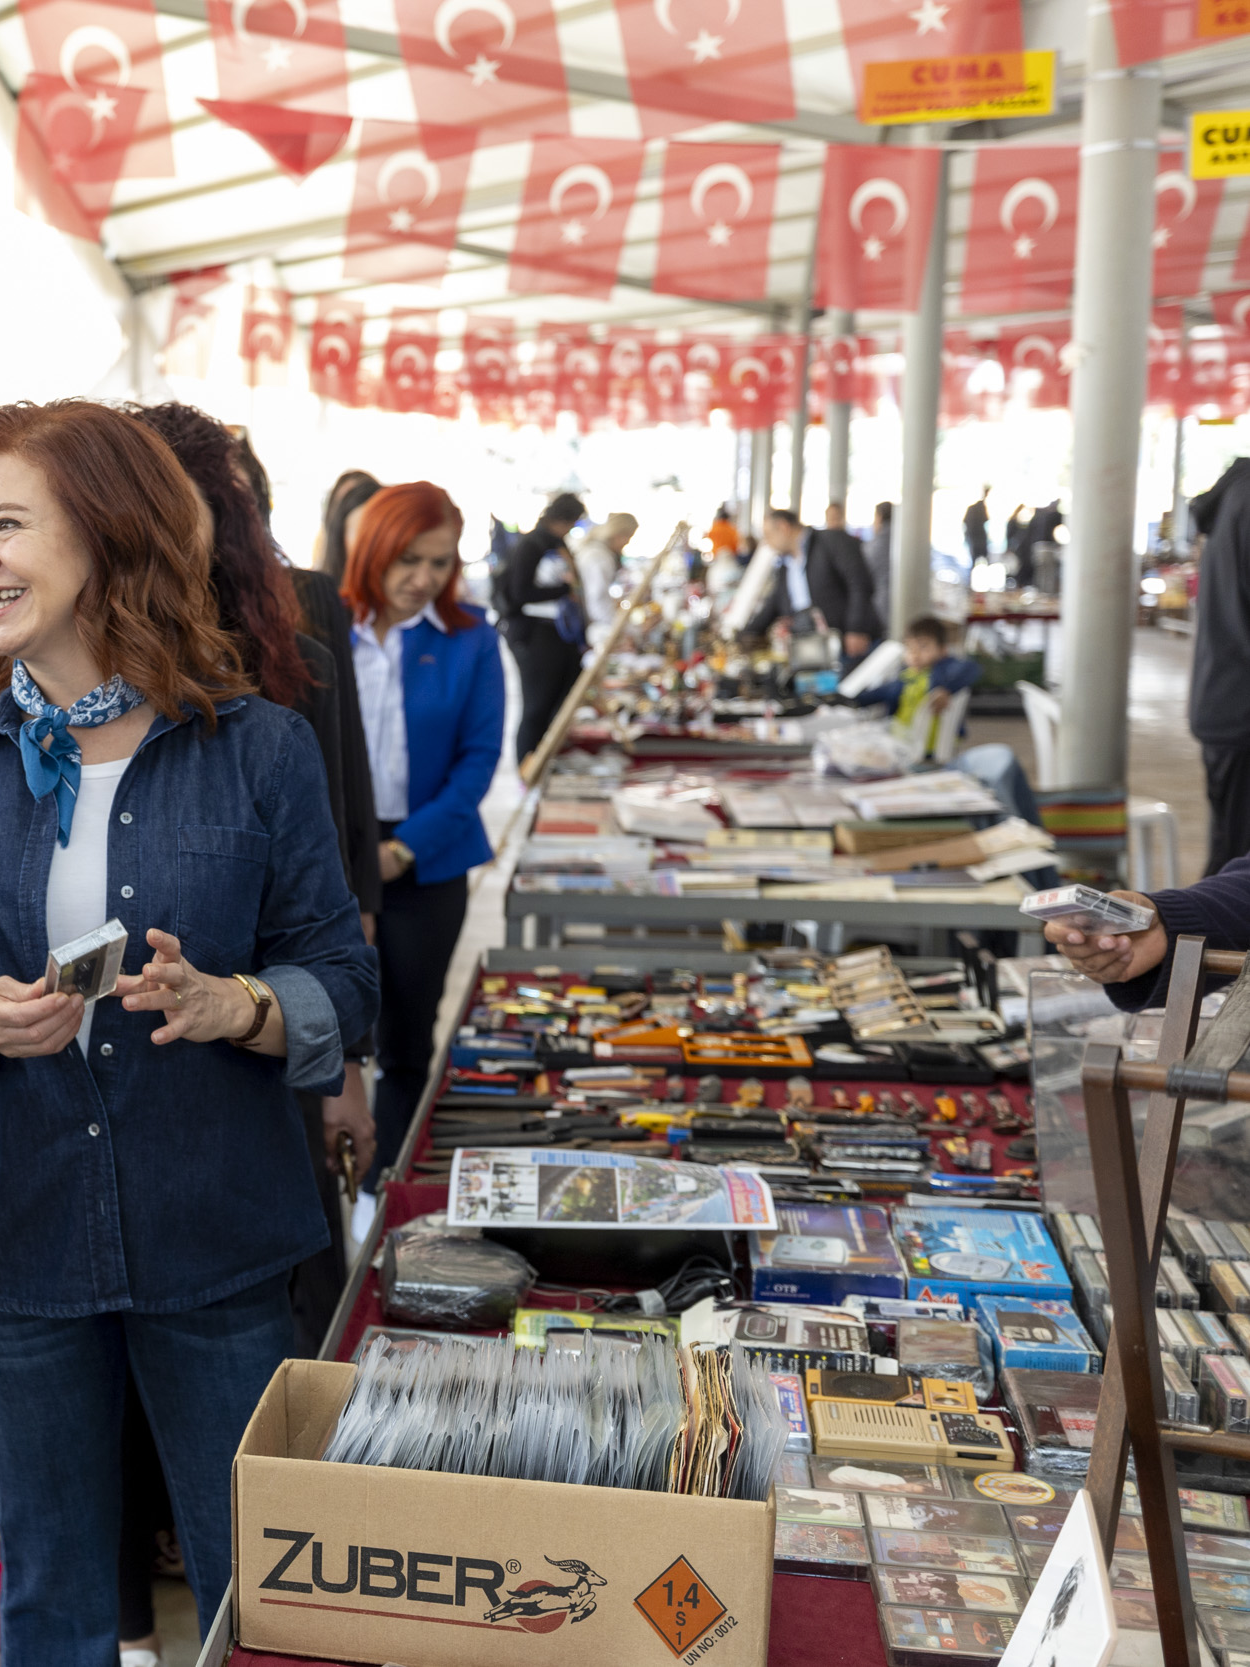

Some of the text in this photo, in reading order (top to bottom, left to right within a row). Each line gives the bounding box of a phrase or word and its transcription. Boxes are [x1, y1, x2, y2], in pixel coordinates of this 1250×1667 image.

[911, 59, 1005, 85] CUMA
[662, 1580, 701, 1609] 1.4
[675, 1611, 687, 1627] S
[675, 1631, 682, 1646] 1
[683, 1615, 739, 1666] UN NO: 0012
